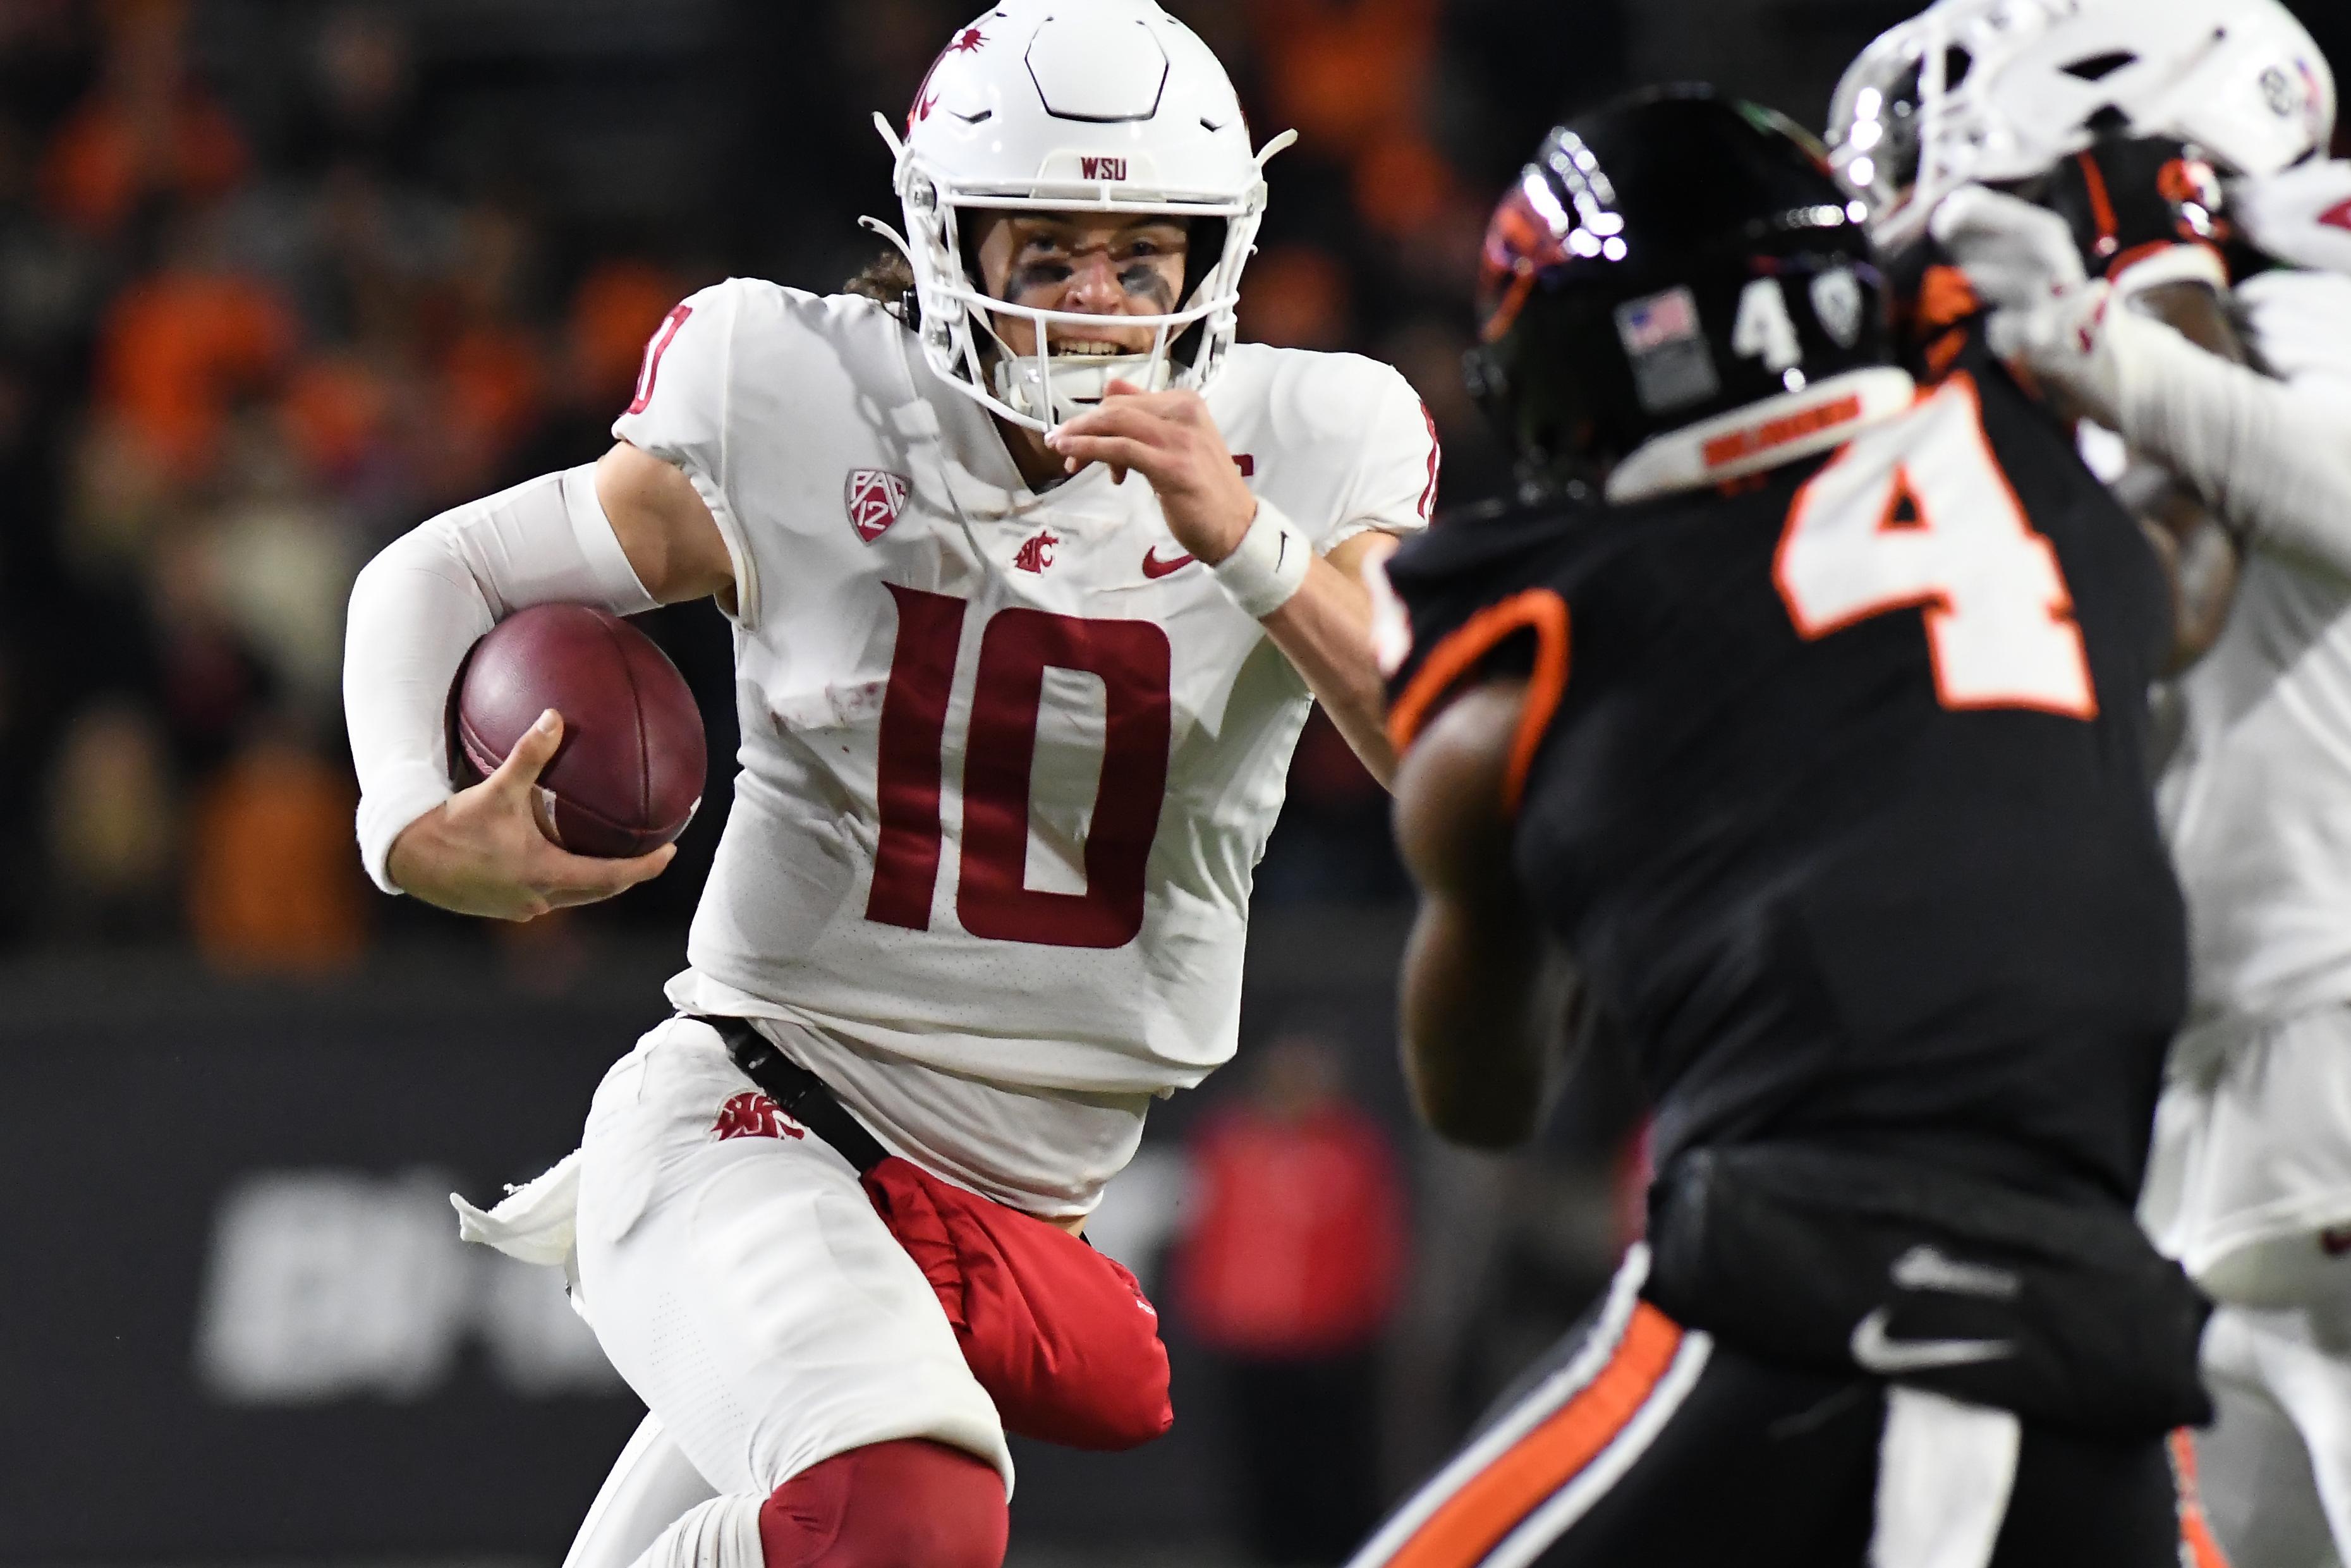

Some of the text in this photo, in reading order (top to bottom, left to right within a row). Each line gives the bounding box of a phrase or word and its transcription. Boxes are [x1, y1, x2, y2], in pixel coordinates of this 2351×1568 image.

[1080, 156, 1126, 181] WSU
[850, 471, 906, 518] PAC
[858, 500, 889, 530] 12
[1772, 371, 2099, 721] 4
[865, 581, 1171, 949] 10
